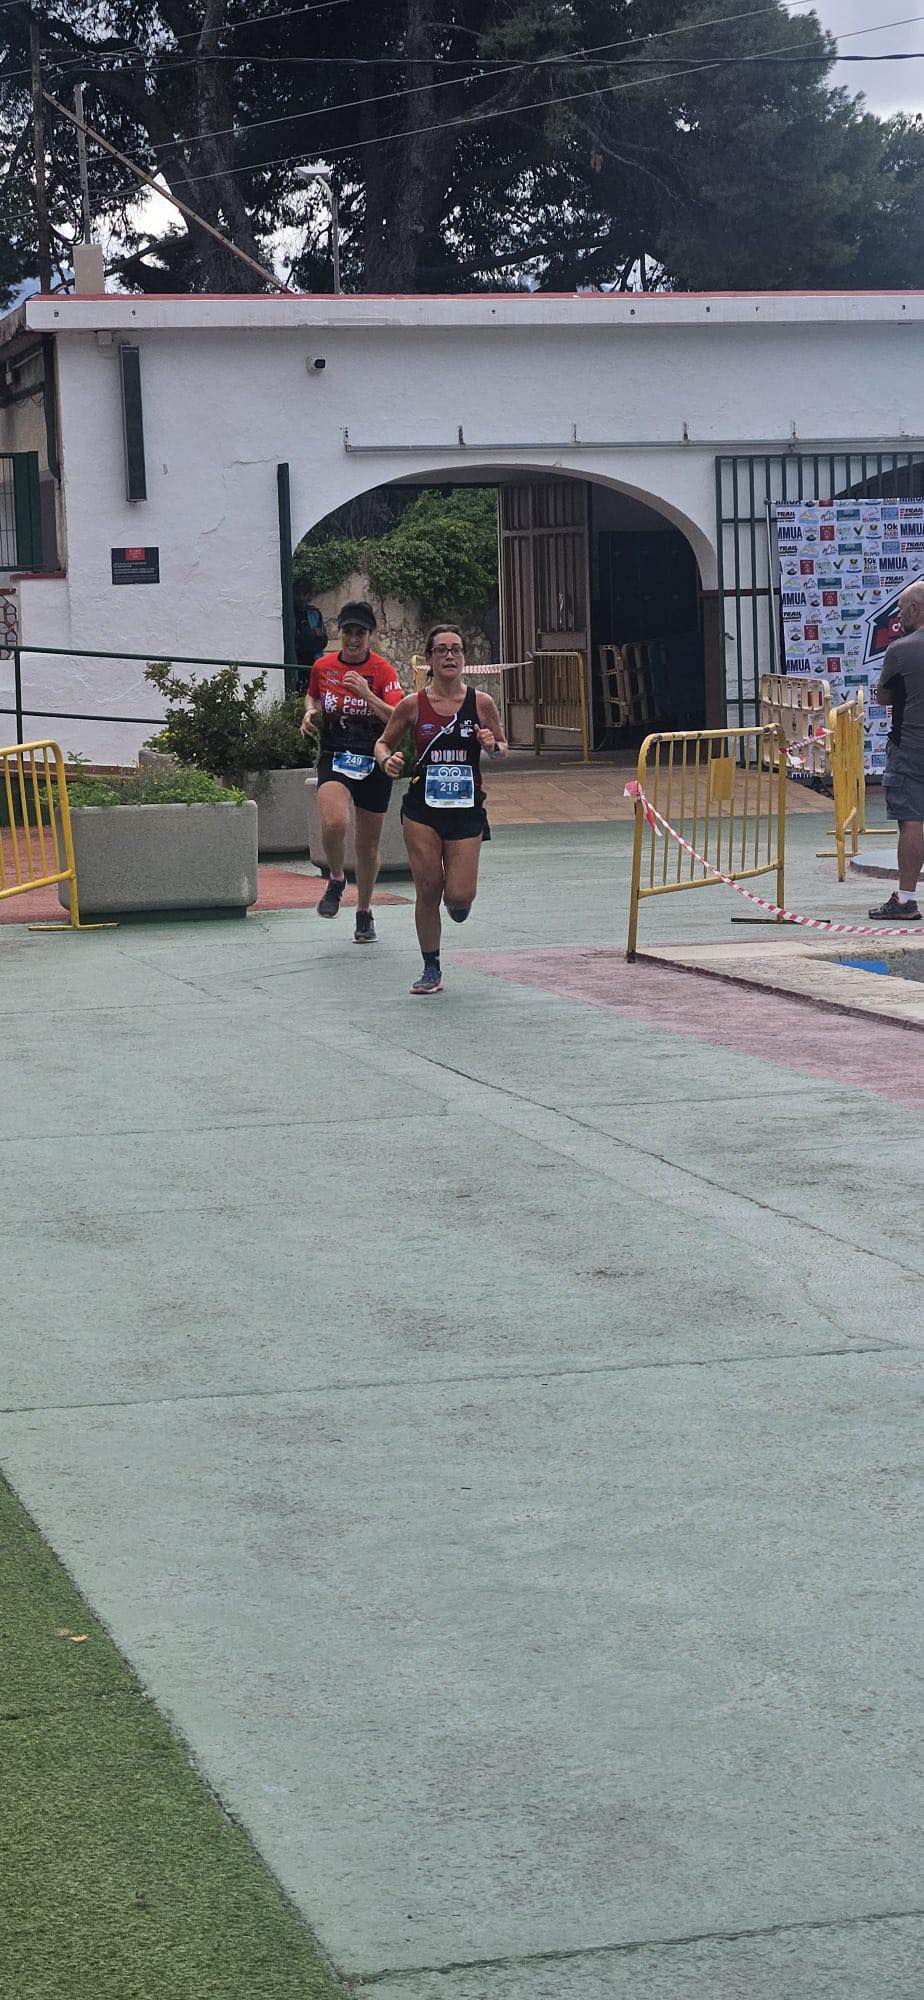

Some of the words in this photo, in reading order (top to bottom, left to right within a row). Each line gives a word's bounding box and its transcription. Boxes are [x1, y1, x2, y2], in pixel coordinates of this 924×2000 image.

[900, 523, 924, 536] MMU
[879, 557, 908, 570] MMUA
[346, 756, 362, 766] 249
[440, 782, 460, 792] 218
